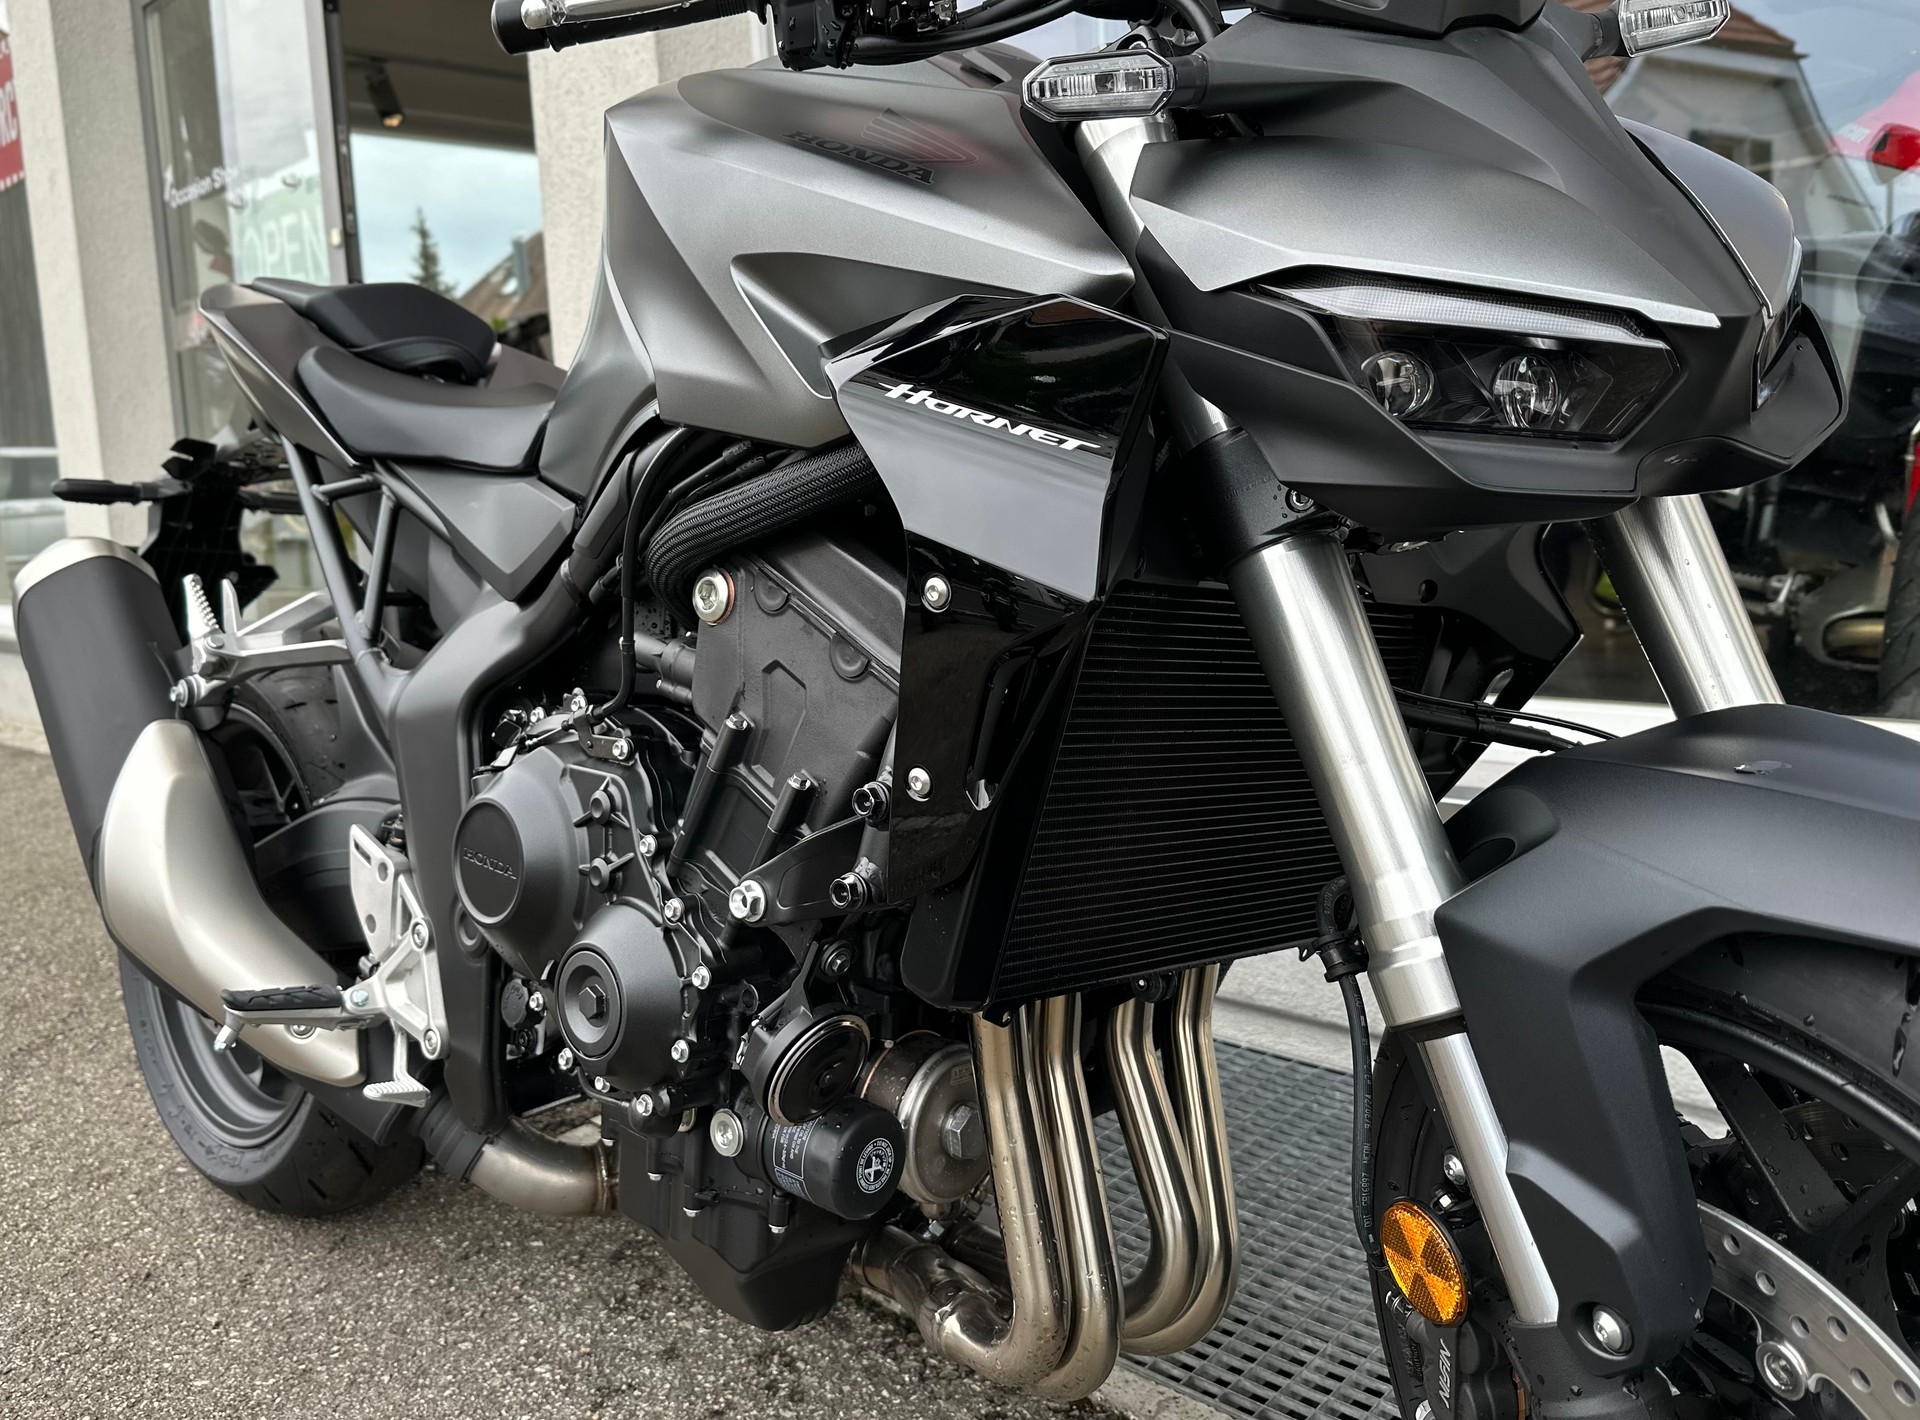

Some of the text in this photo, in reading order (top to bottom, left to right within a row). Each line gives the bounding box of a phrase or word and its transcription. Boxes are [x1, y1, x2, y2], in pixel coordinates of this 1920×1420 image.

[782, 131, 934, 185] HONDA
[170, 176, 213, 209] Occasion
[243, 204, 331, 284] OPEN
[464, 847, 517, 880] HONDA
